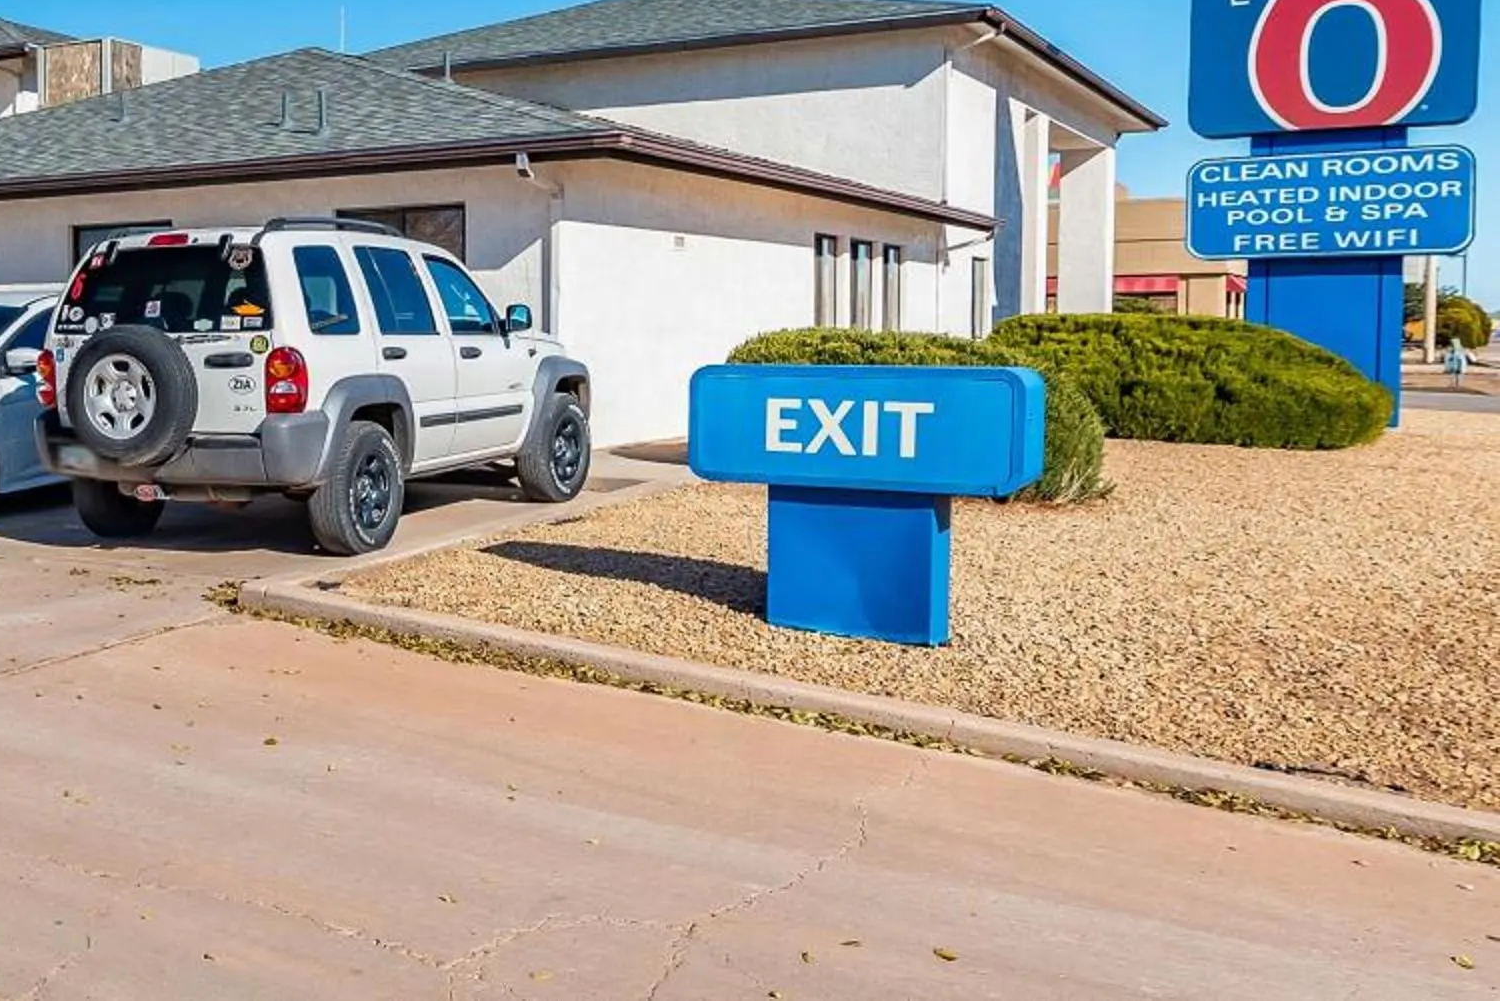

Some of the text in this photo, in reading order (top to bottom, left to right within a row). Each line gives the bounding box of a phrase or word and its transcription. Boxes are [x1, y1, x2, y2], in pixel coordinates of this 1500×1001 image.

[1200, 152, 1461, 184] CLEAN ROOMS
[1197, 180, 1463, 208] HEATED INDOOR
[1227, 202, 1429, 226] POOL & SPA
[1233, 228, 1418, 252] FREE WIFI
[765, 397, 935, 459] EXIT
